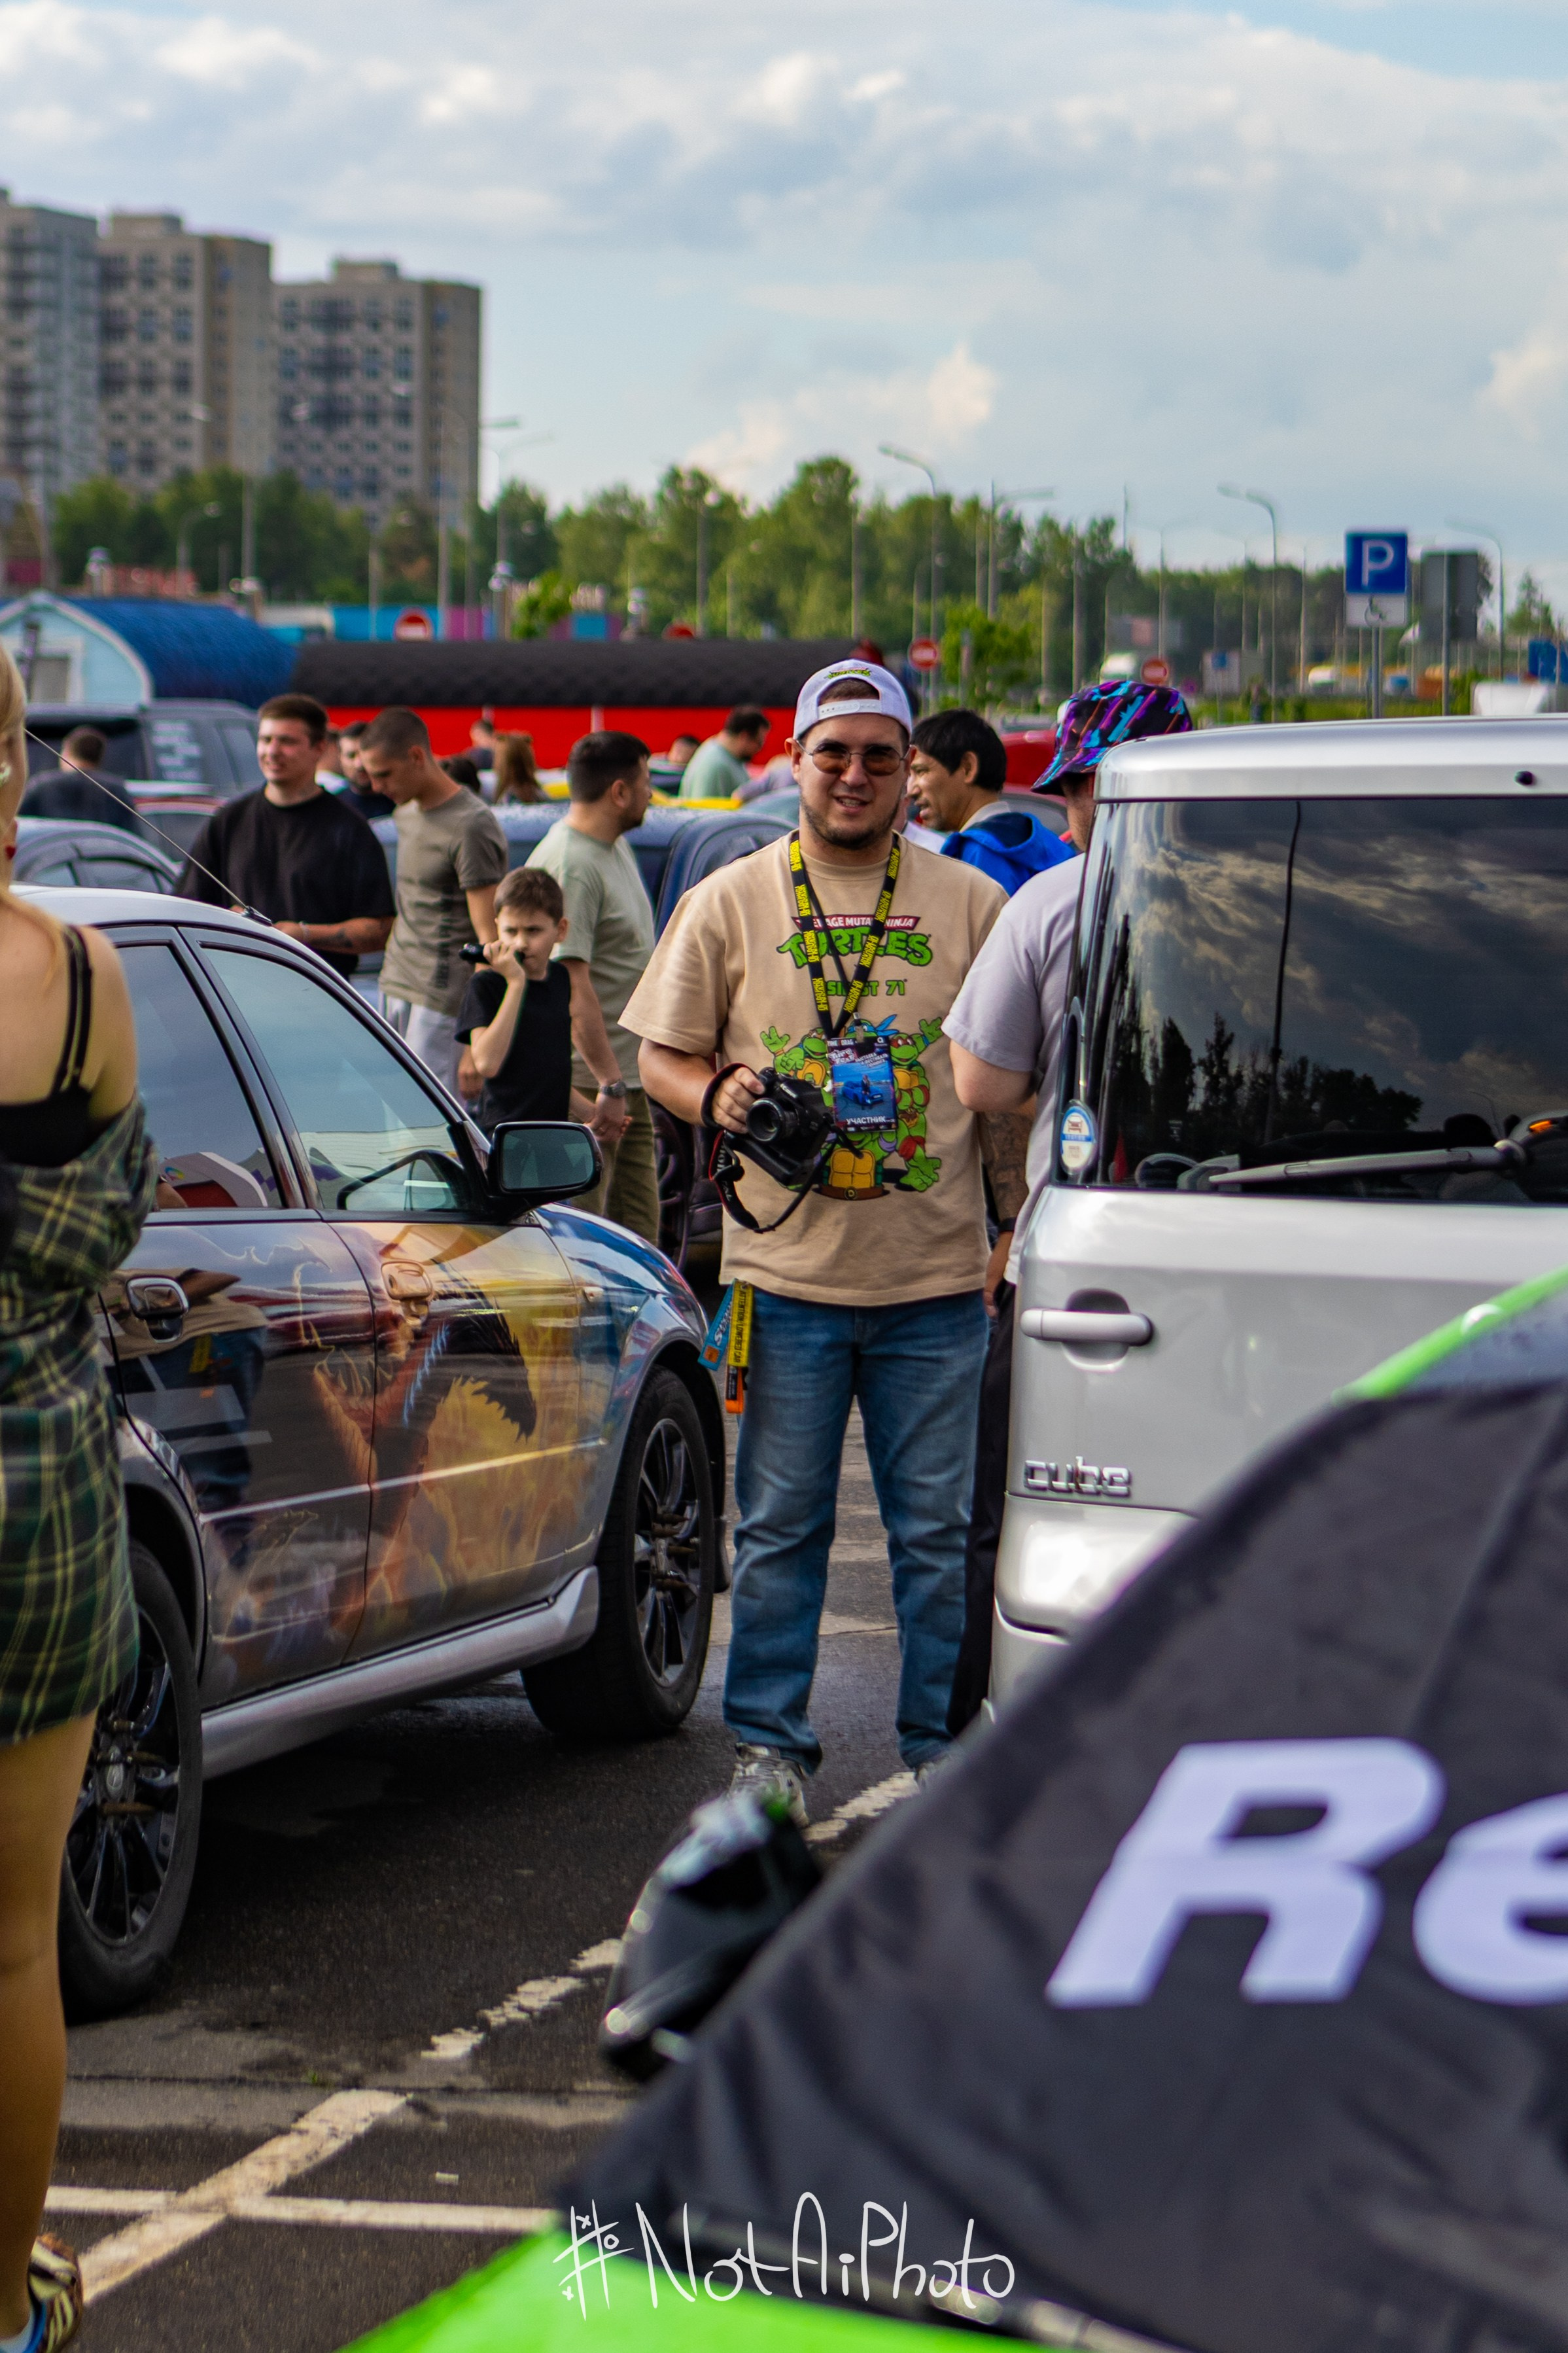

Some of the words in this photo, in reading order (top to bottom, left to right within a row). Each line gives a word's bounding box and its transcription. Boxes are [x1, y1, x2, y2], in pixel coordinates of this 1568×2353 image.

[1361, 539, 1395, 588] P
[846, 1116, 886, 1125] УЧАСТНИК
[1024, 1456, 1131, 1496] cube
[1046, 1736, 1568, 2009] Re
